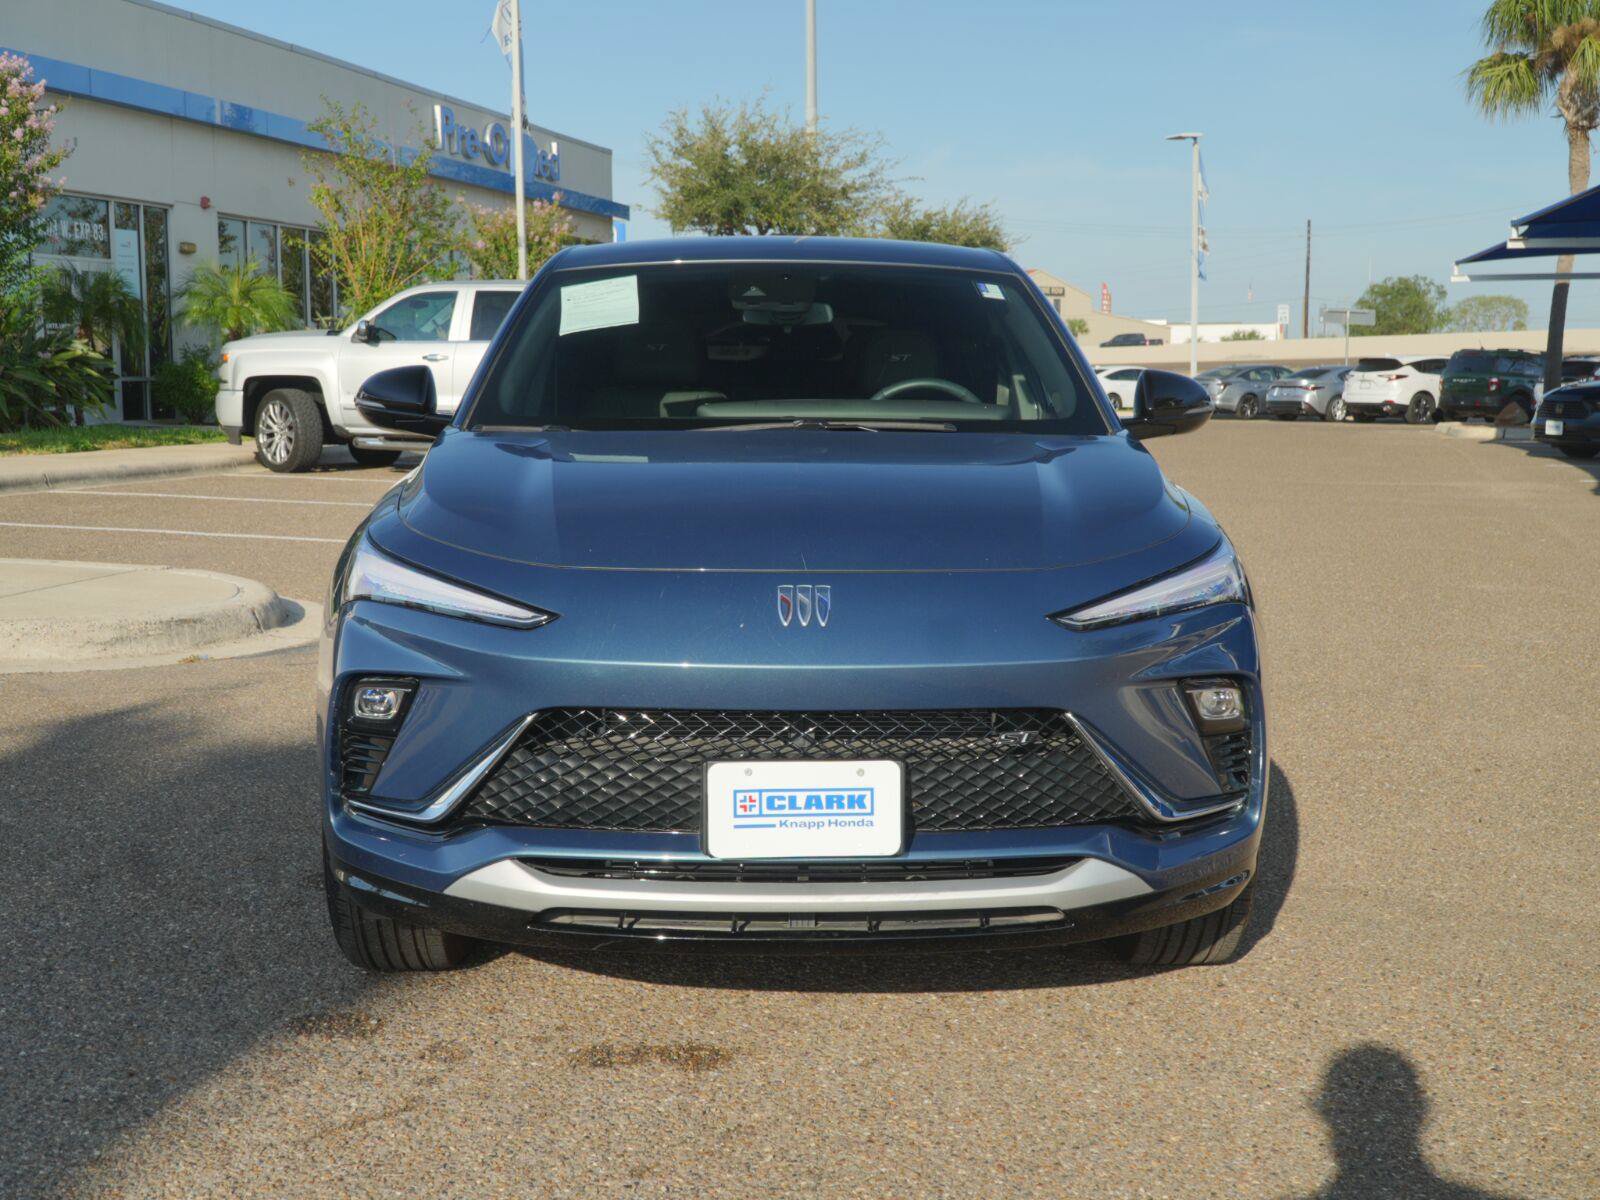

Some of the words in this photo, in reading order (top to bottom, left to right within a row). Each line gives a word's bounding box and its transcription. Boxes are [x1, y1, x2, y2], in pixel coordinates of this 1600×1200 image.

[433, 104, 560, 182] Pre-Oed
[74, 221, 91, 240] EXP
[93, 224, 104, 241] 83
[766, 794, 868, 811] CLARK
[779, 819, 825, 830] Knapp
[827, 819, 874, 828] Honda
